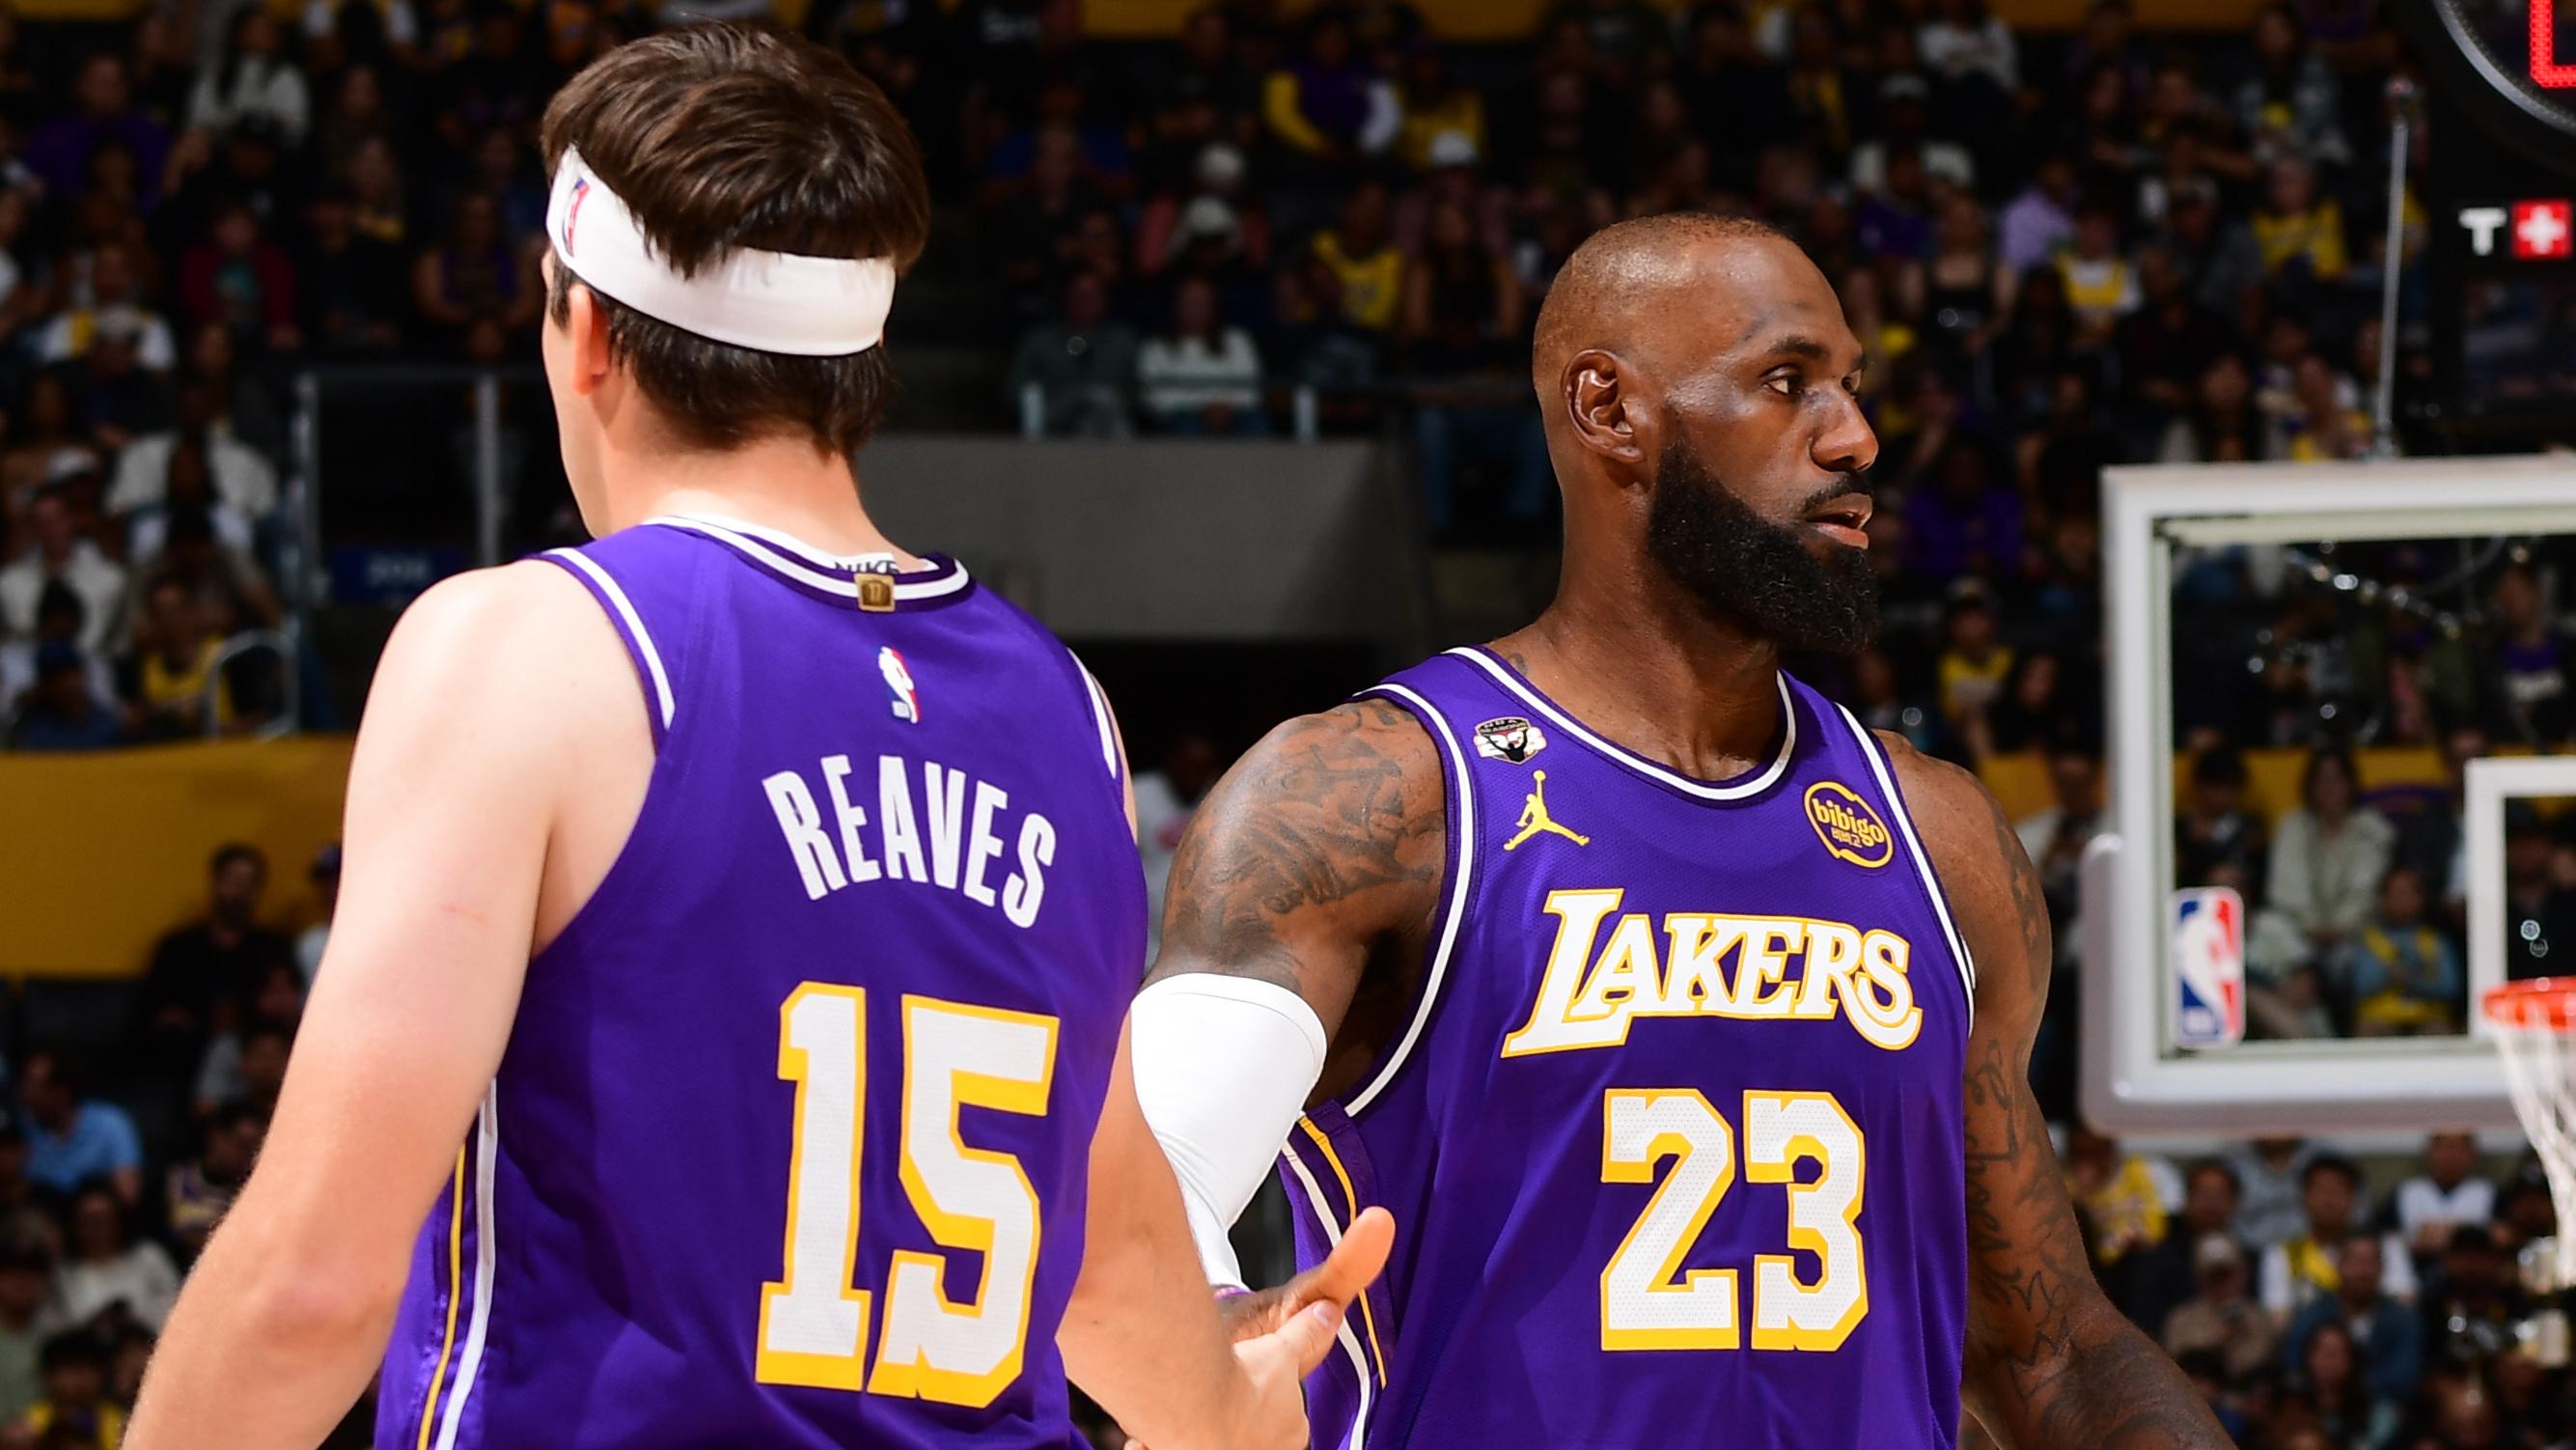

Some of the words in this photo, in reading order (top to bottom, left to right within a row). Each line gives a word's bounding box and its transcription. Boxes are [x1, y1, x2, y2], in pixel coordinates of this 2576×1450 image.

[761, 754, 1057, 929] REAVES
[1812, 797, 1885, 848] bibigo
[1500, 887, 1924, 1059] LAKERS
[755, 980, 1061, 1409] 15
[1600, 1087, 1870, 1352] 23
